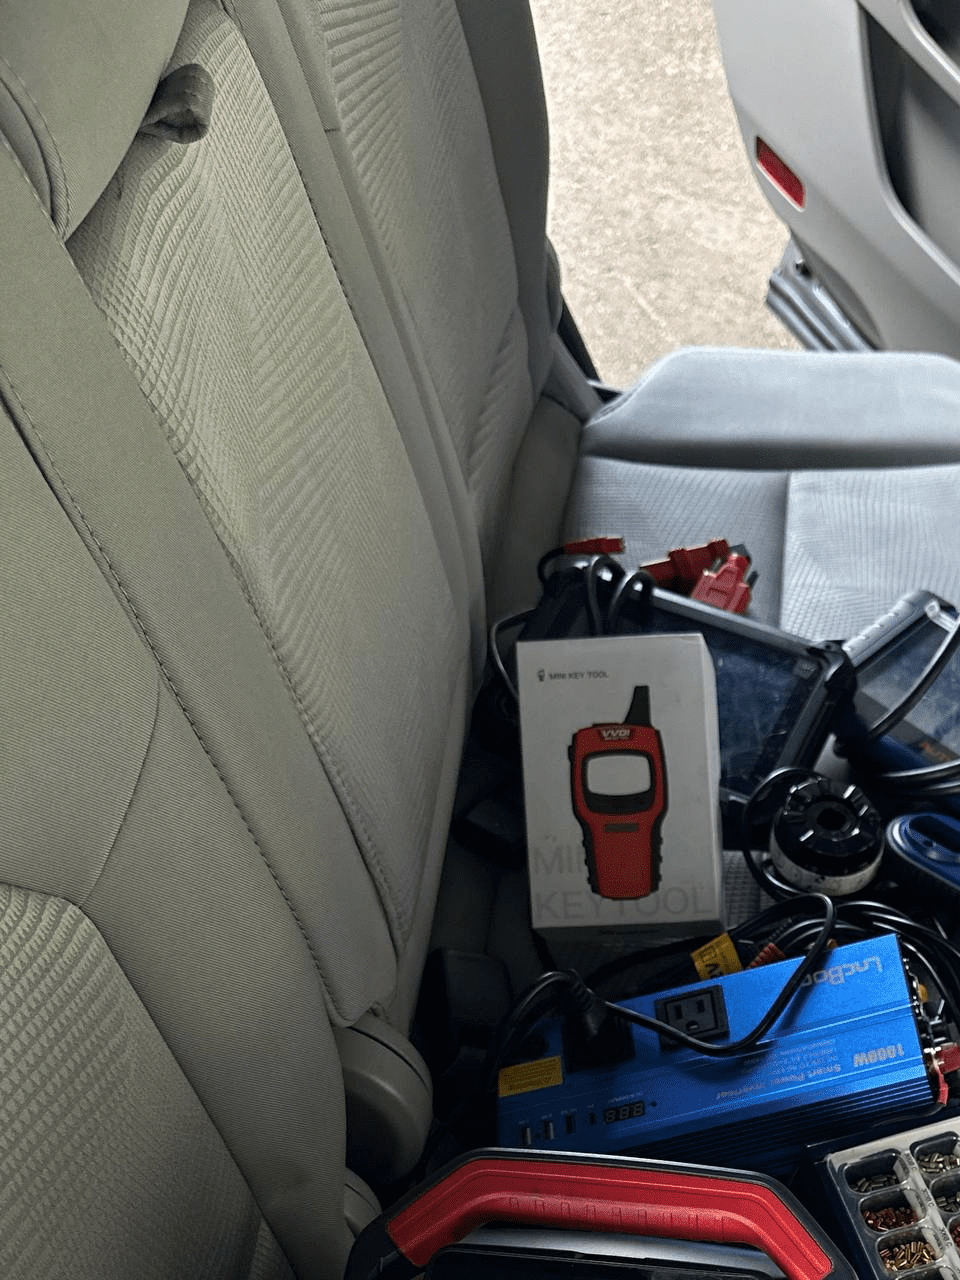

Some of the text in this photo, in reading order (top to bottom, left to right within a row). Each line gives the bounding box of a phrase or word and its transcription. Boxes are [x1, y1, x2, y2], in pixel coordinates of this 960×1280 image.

[549, 670, 609, 680] MINI KEY TOOL
